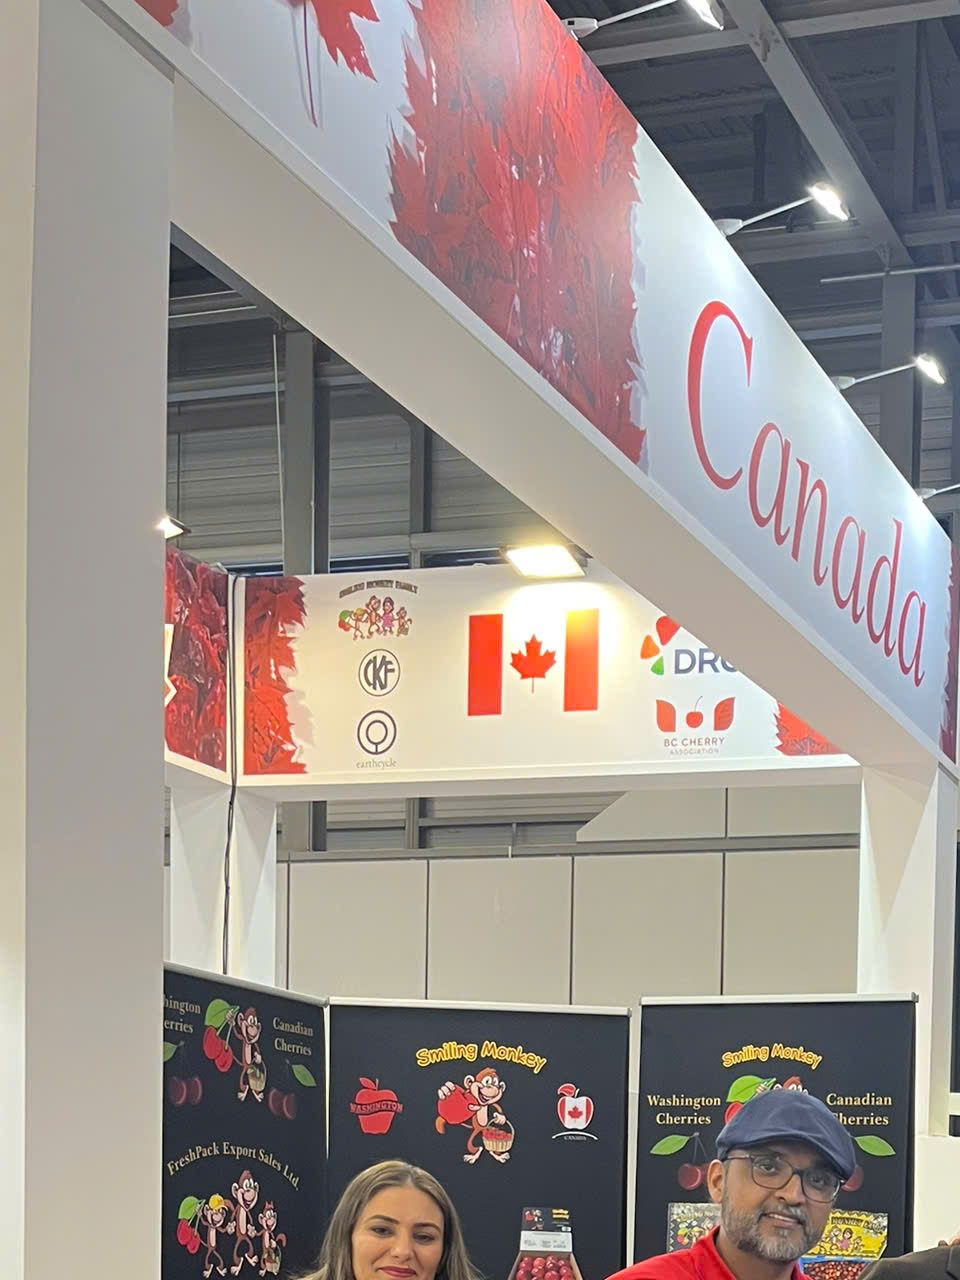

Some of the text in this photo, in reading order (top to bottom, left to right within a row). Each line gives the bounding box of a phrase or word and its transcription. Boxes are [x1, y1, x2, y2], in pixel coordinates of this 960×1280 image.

[687, 300, 927, 687] Canada
[664, 736, 725, 748] BC CHERRY
[670, 748, 720, 756] ASSOCIATION
[356, 758, 397, 769] earthcycle
[163, 994, 202, 1015] hington
[164, 1018, 193, 1034] erries
[273, 1016, 314, 1037] Canadian
[274, 1038, 312, 1056] Cherries
[415, 1040, 547, 1074] Smiling Monkey
[722, 1043, 822, 1070] Smiling Monkey
[647, 1094, 721, 1110] Washington
[826, 1092, 892, 1106] Canadian
[350, 1101, 403, 1114] WASHINGTON
[656, 1112, 712, 1125] Cherries
[167, 1141, 300, 1191] FreshPack Export Sales Ltd.
